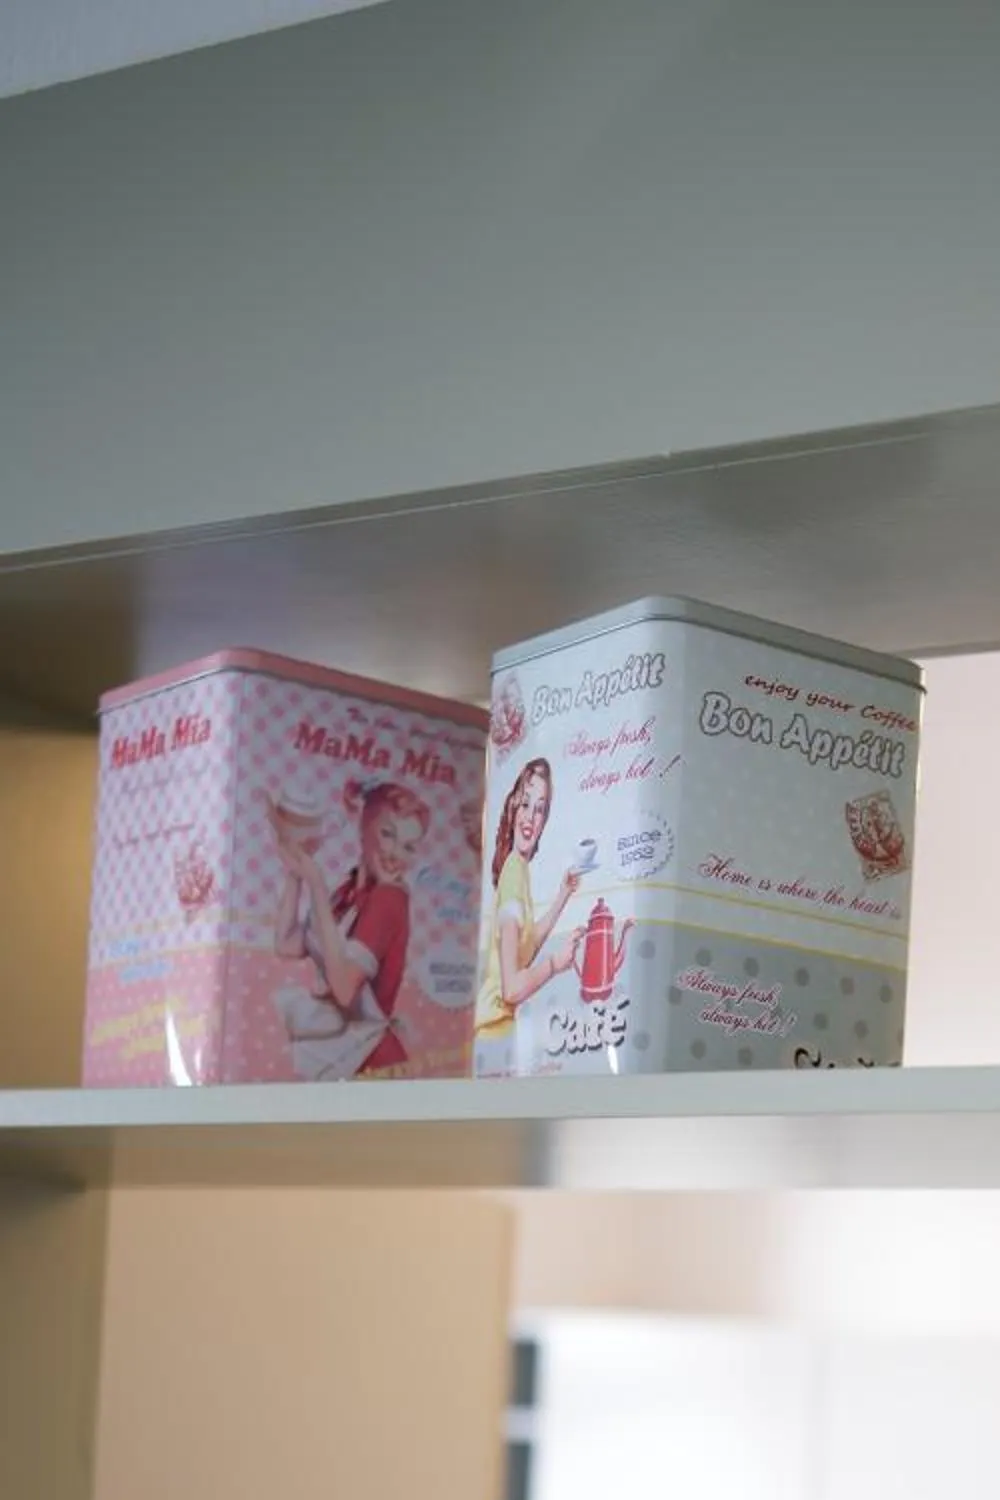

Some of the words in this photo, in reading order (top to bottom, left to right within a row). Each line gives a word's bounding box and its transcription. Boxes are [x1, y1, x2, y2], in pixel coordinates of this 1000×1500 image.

[744, 674, 800, 702] enjoy
[805, 691, 857, 713] your
[700, 691, 774, 745] Bon
[780, 713, 905, 778] Appétit
[401, 748, 458, 787] Mia
[699, 852, 752, 885] Home
